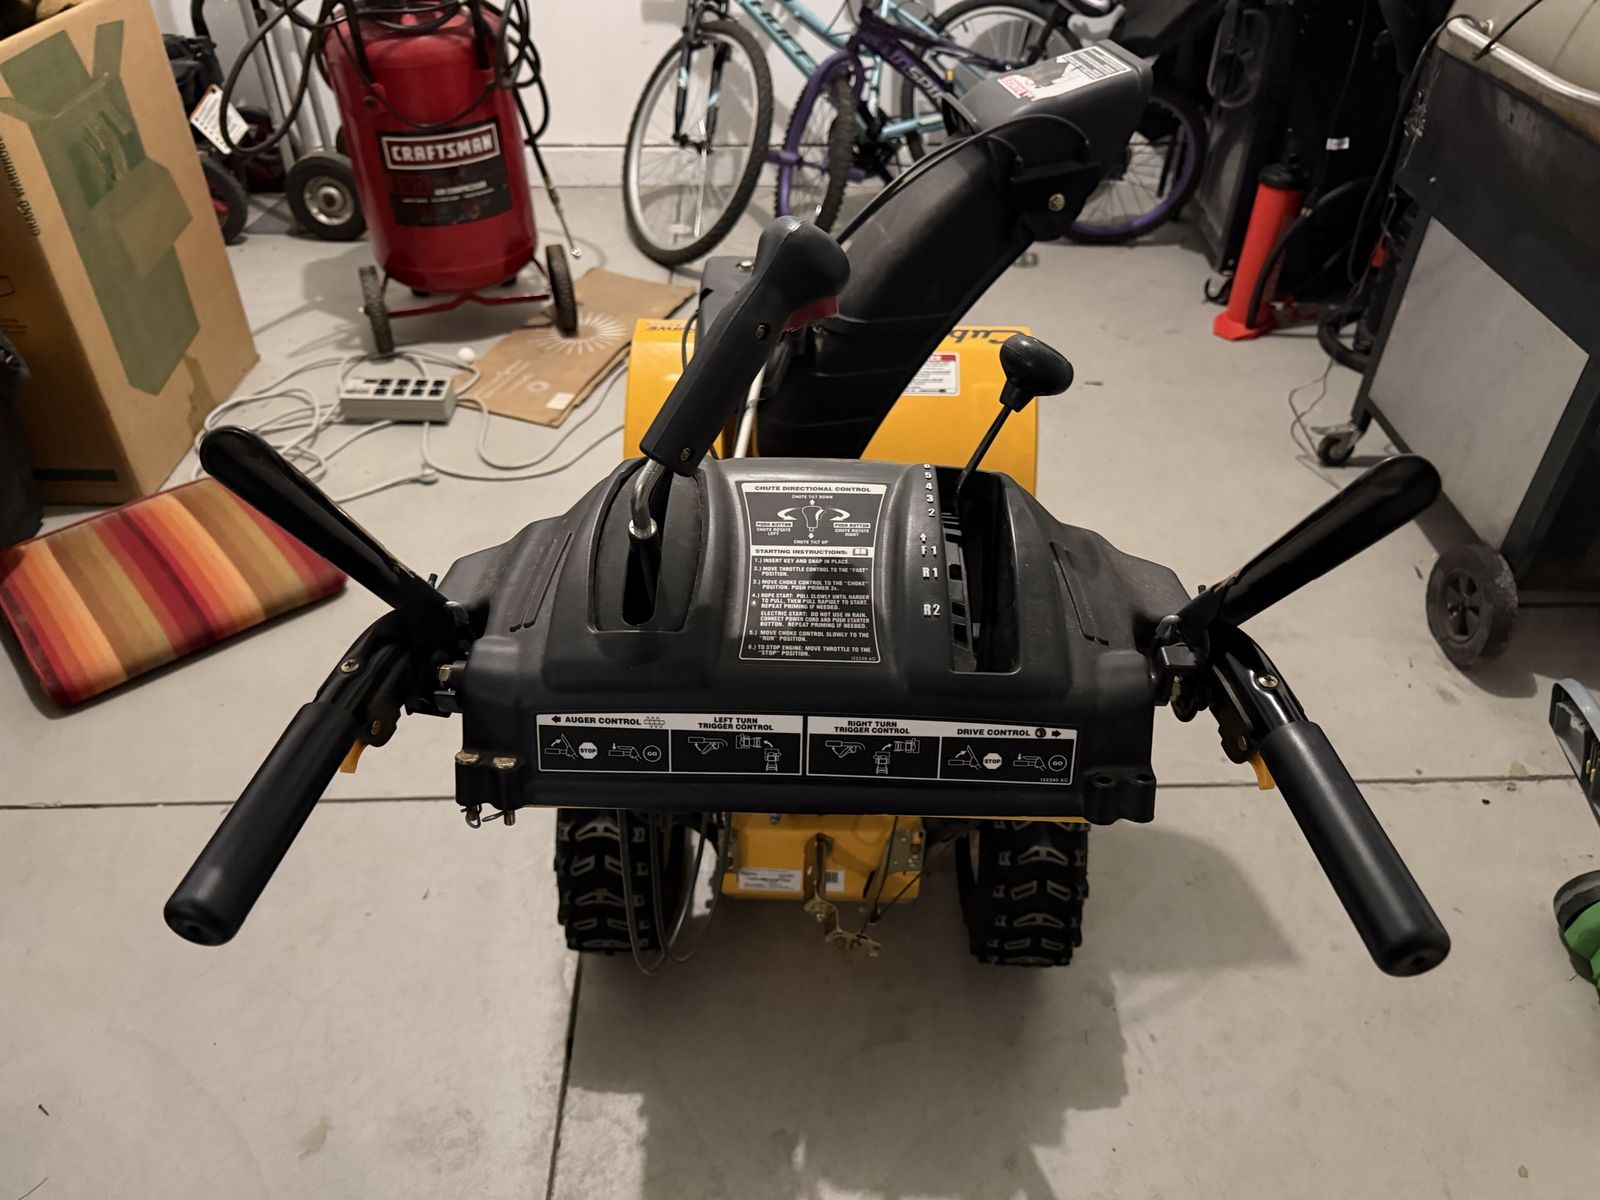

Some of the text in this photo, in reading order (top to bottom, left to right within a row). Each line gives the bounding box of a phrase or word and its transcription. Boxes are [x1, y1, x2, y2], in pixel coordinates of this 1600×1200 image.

[391, 132, 493, 162] CRAFTSMAN
[17, 199, 41, 237] GRAND
[924, 471, 932, 479] 5
[925, 482, 933, 490] 4
[926, 494, 934, 503] 3
[928, 508, 936, 517] 2
[564, 716, 642, 726] AUGER CONTROL
[956, 728, 1031, 737] DRIVE CONTROL
